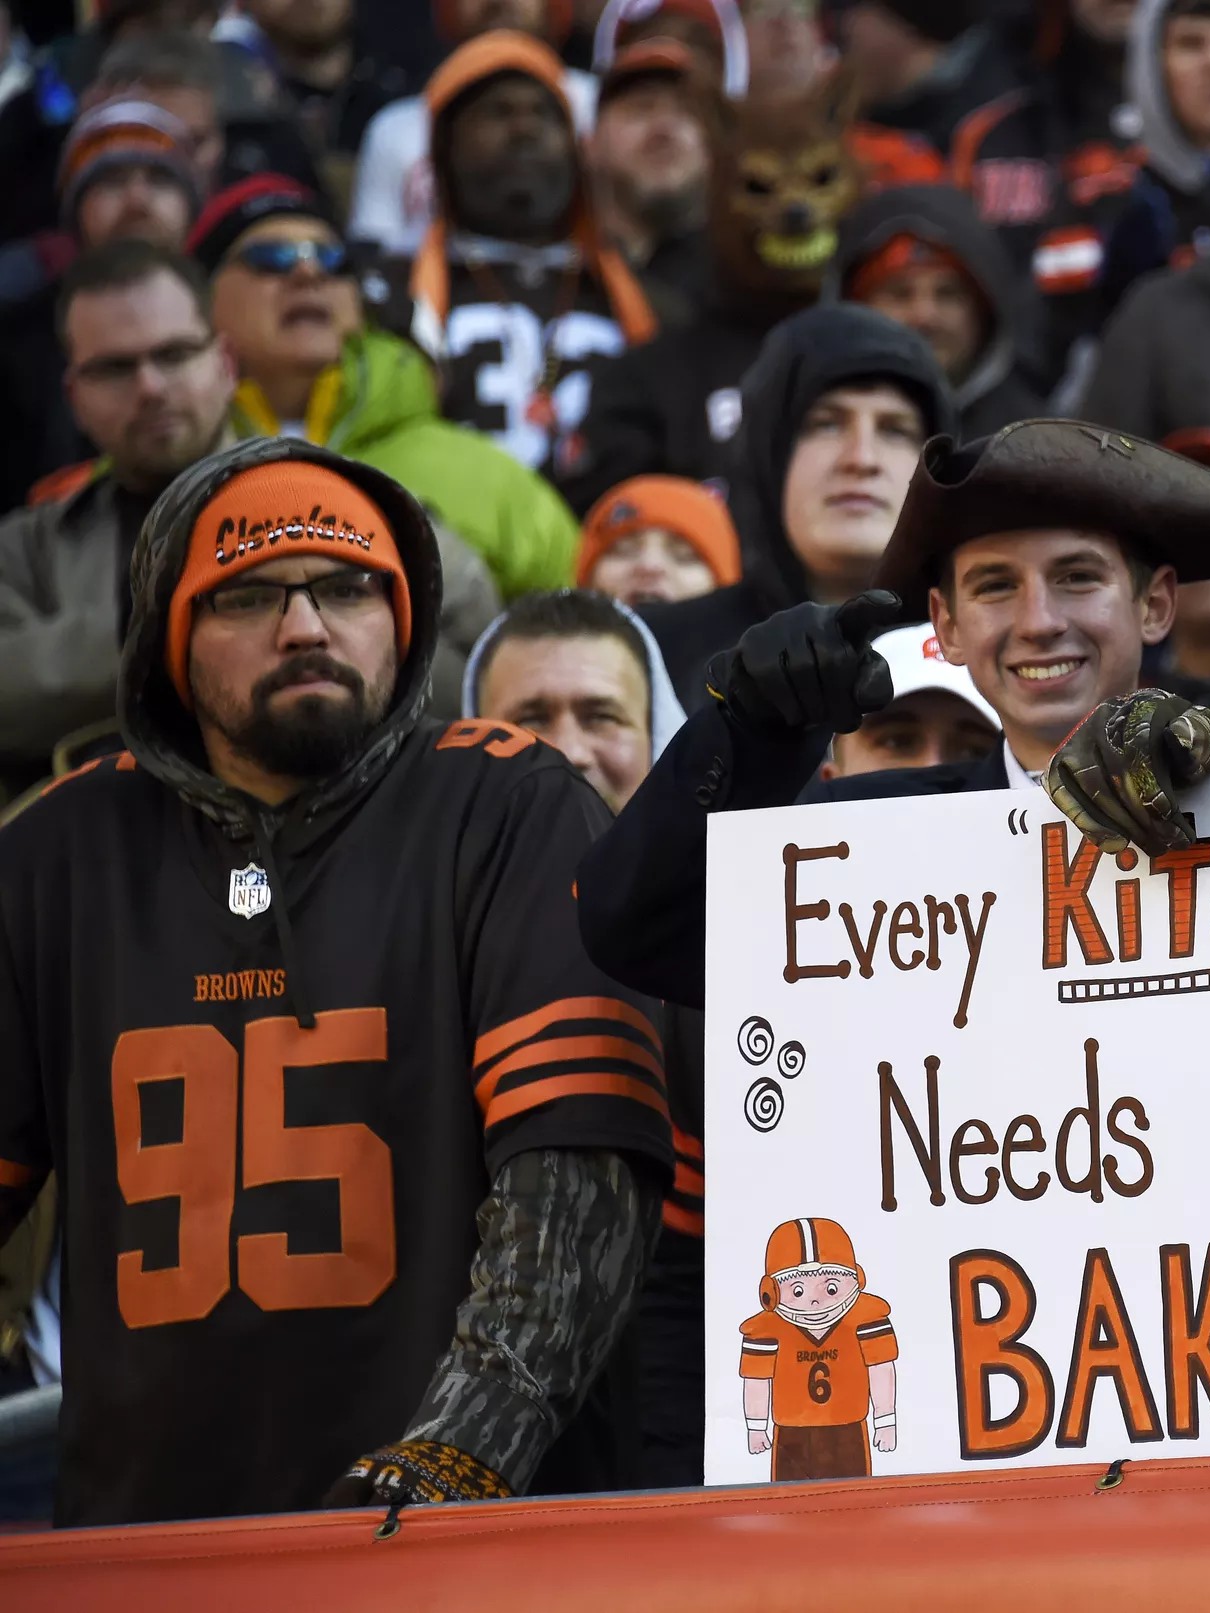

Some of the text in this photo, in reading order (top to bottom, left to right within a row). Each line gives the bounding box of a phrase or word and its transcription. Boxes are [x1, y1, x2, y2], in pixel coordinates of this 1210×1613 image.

[237, 888, 265, 908] NFL
[782, 841, 997, 1029] Every
[194, 968, 287, 1002] BROWNS
[876, 1037, 1155, 1212] Needs
[111, 1006, 397, 1330] 95
[796, 1348, 839, 1363] BROWNS
[808, 1361, 832, 1404] 6
